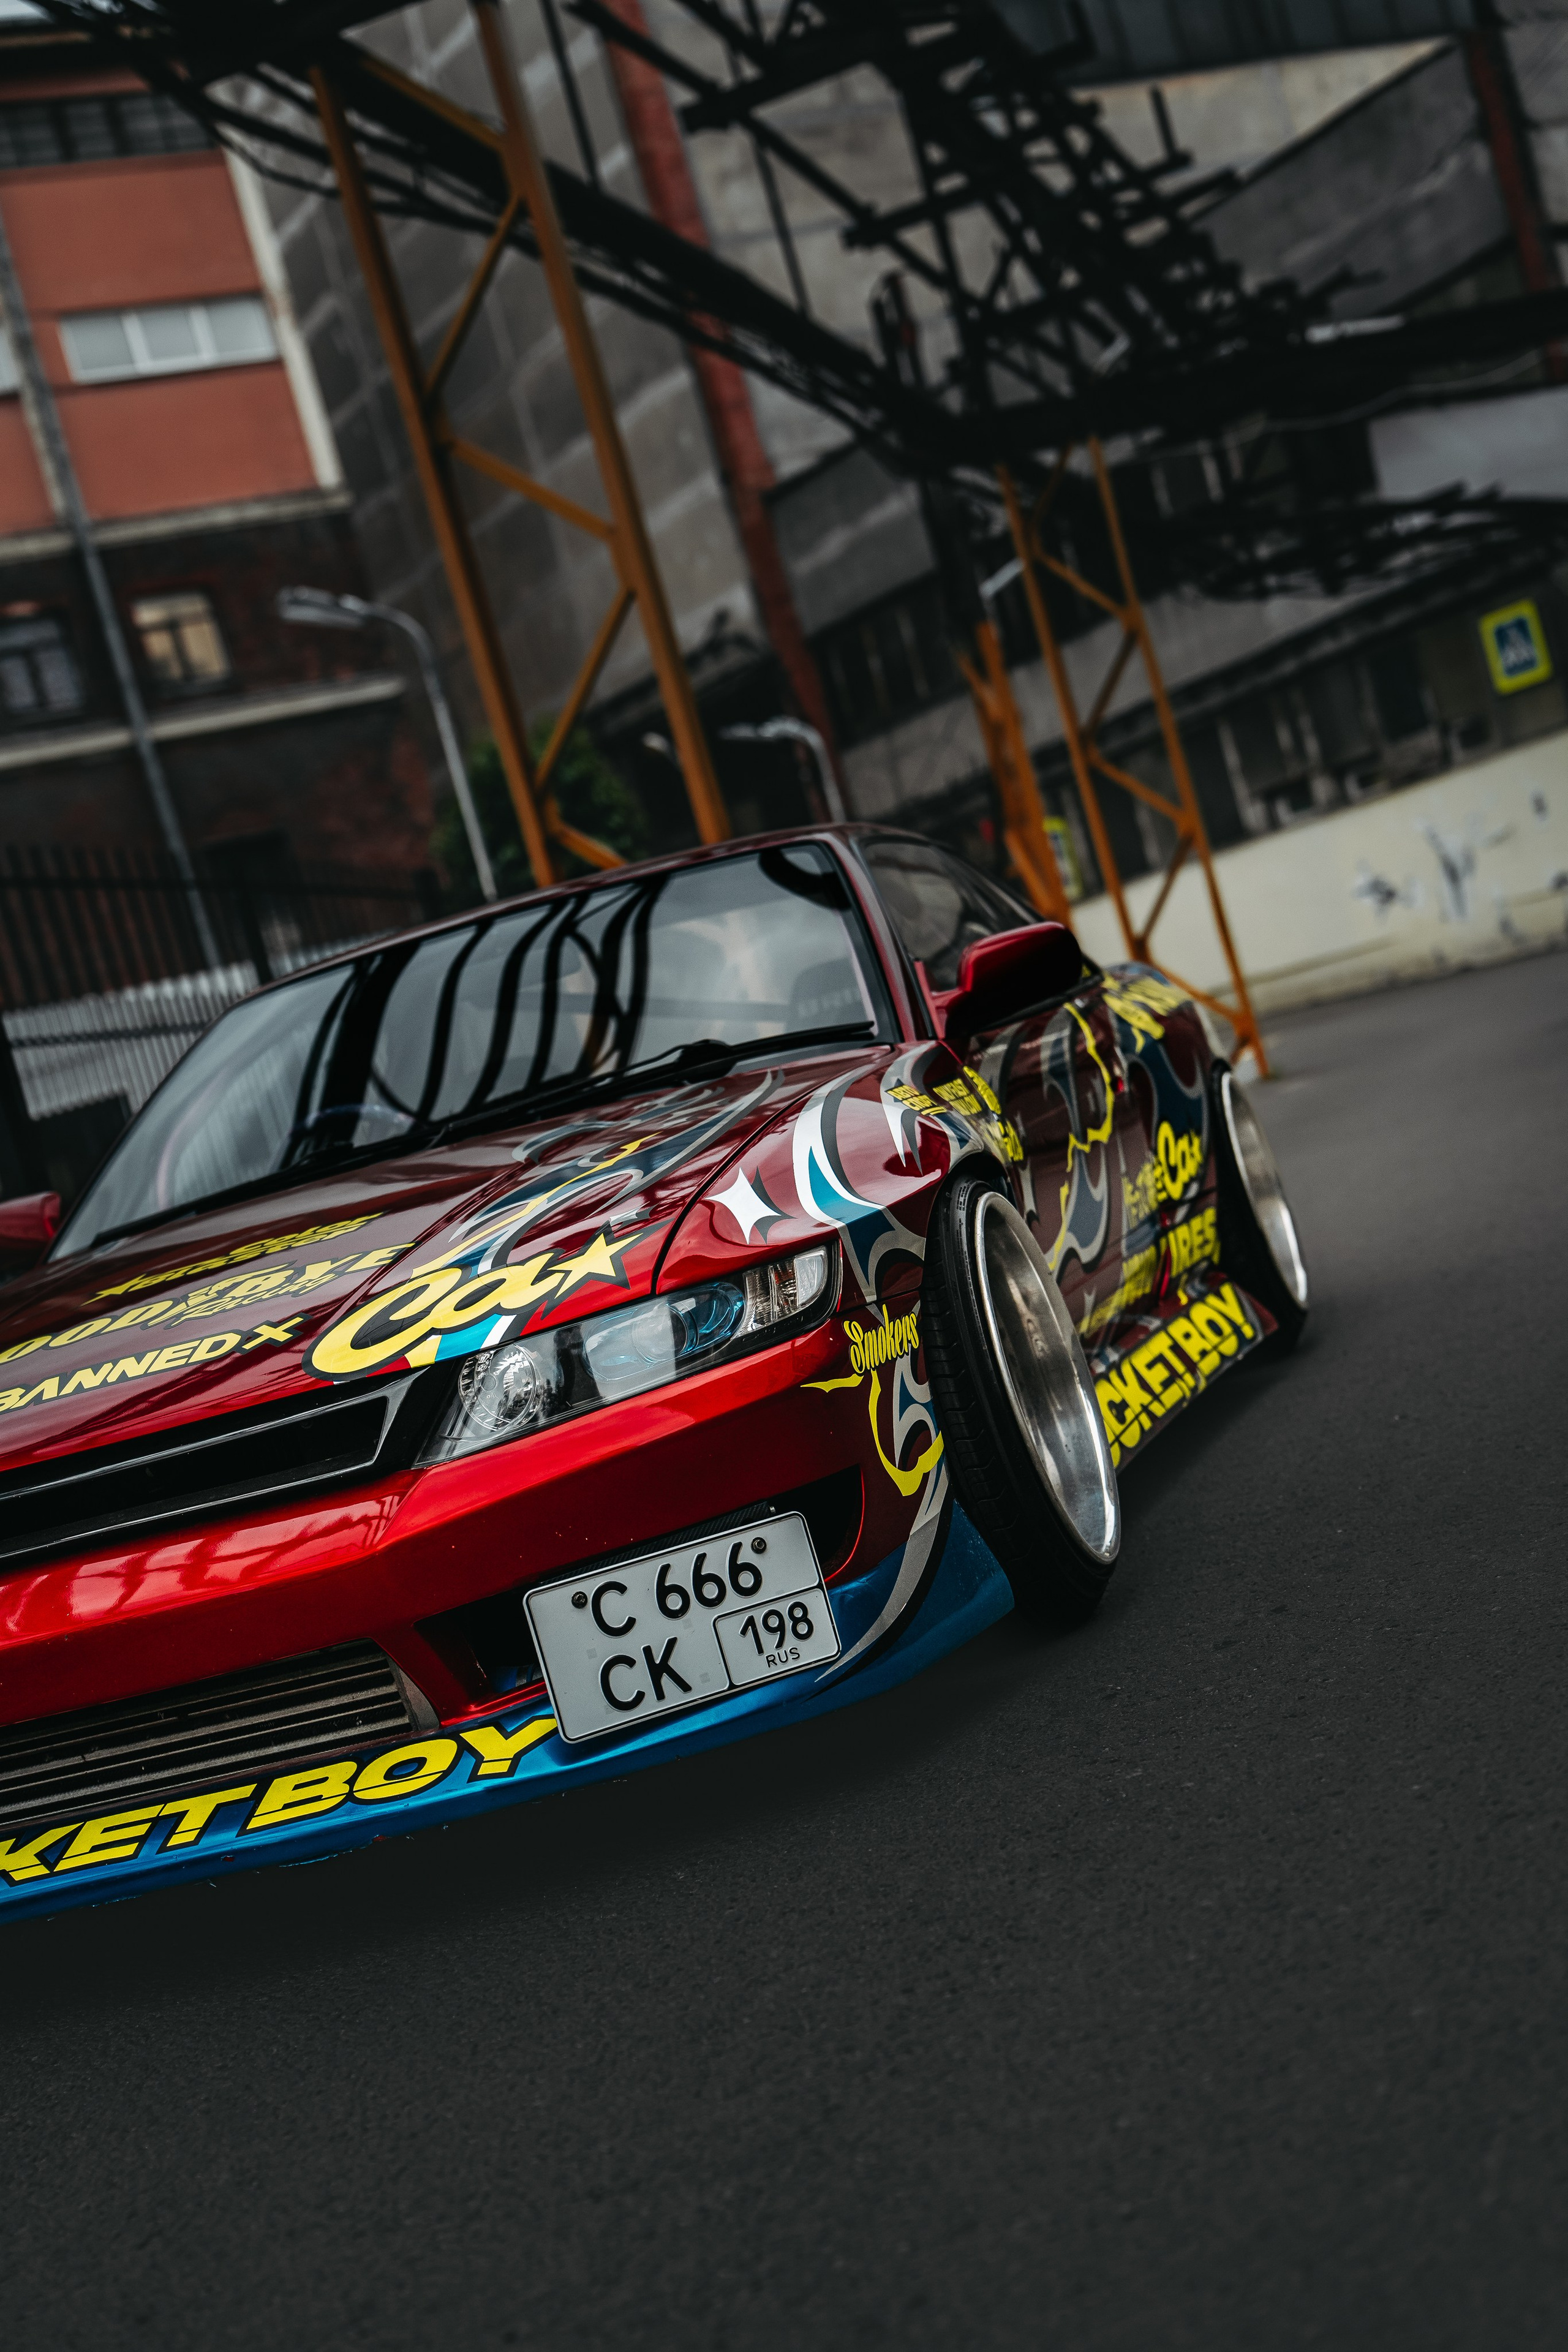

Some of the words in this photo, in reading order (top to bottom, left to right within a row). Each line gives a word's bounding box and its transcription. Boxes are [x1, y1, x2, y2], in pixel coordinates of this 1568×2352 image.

[127, 1226, 362, 1293] Blaster
[229, 1212, 384, 1256] Color
[171, 1273, 337, 1326] Racing
[843, 1303, 919, 1374] Smokers
[1095, 1283, 1254, 1468] CKETBOY
[590, 1580, 637, 1638] C
[654, 1541, 763, 1621] 666
[739, 1600, 815, 1656] 198
[766, 1647, 801, 1668] RUS
[598, 1637, 693, 1711] CK
